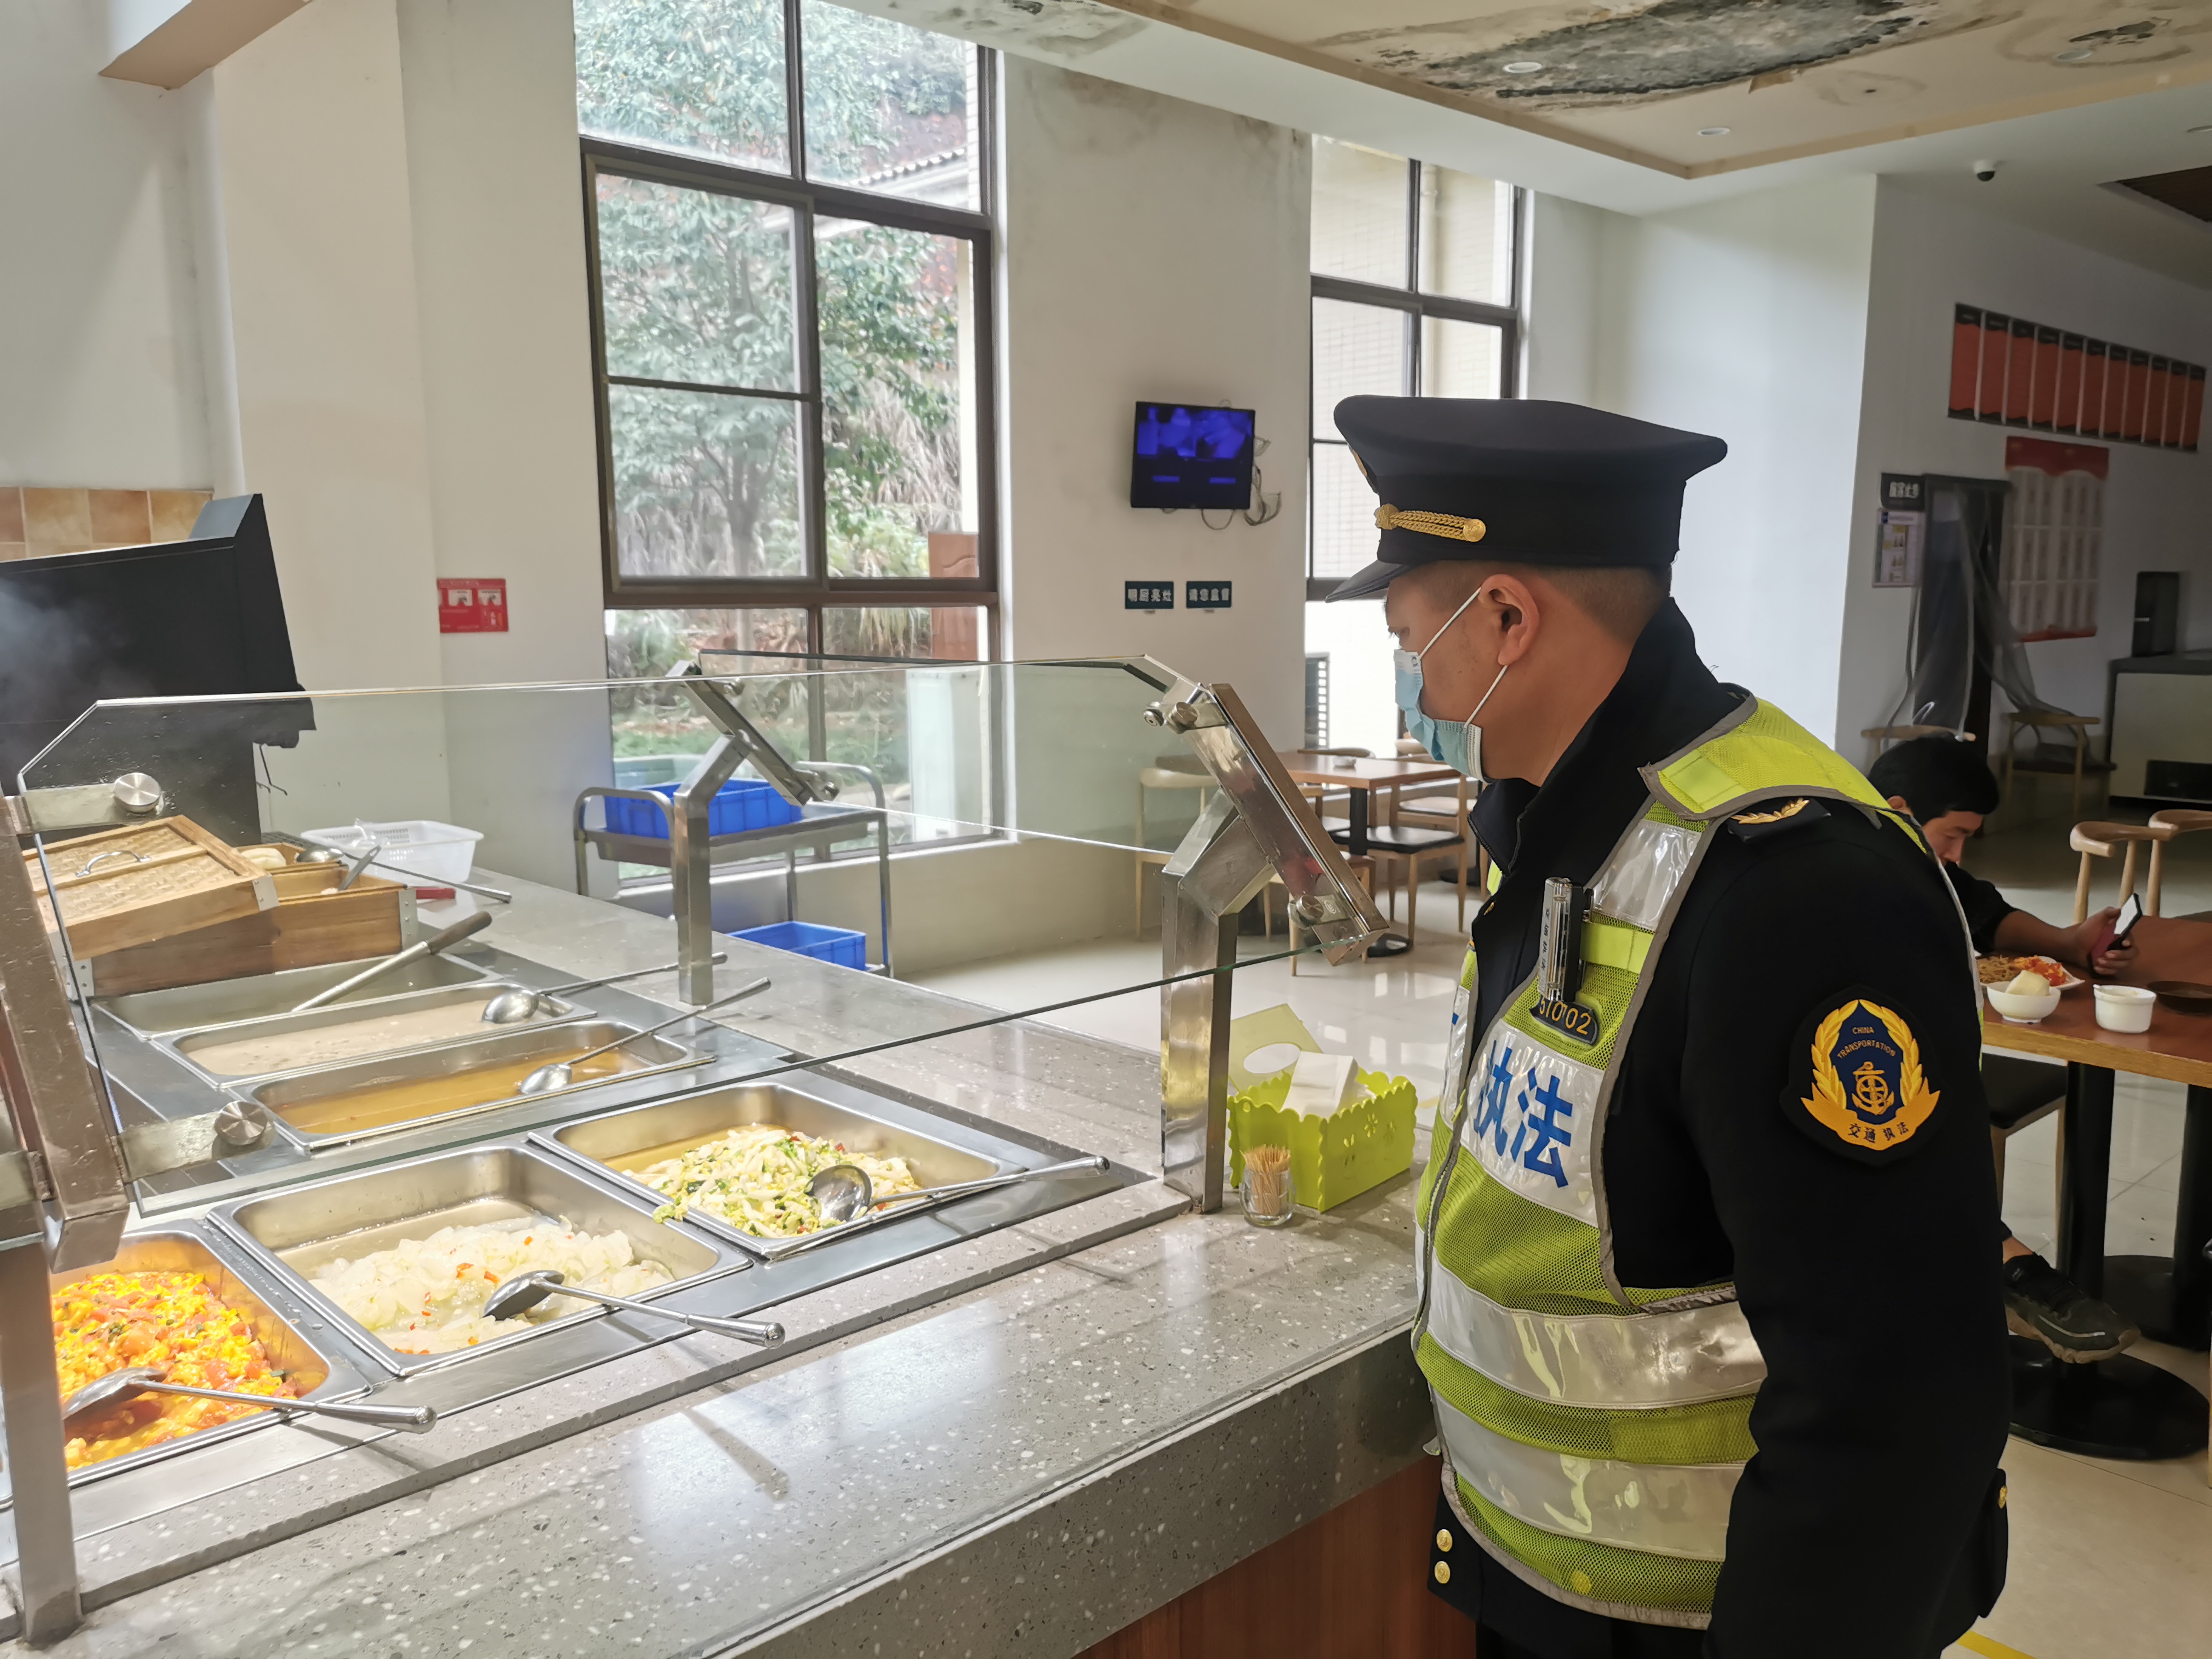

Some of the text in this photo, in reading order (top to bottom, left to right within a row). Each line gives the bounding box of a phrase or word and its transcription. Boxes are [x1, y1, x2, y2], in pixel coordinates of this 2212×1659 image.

[1837, 1039, 1896, 1059] TRANSPORTATION
[1473, 1040, 1573, 1188] 执法
[1847, 1122, 1909, 1144] 交通执法
